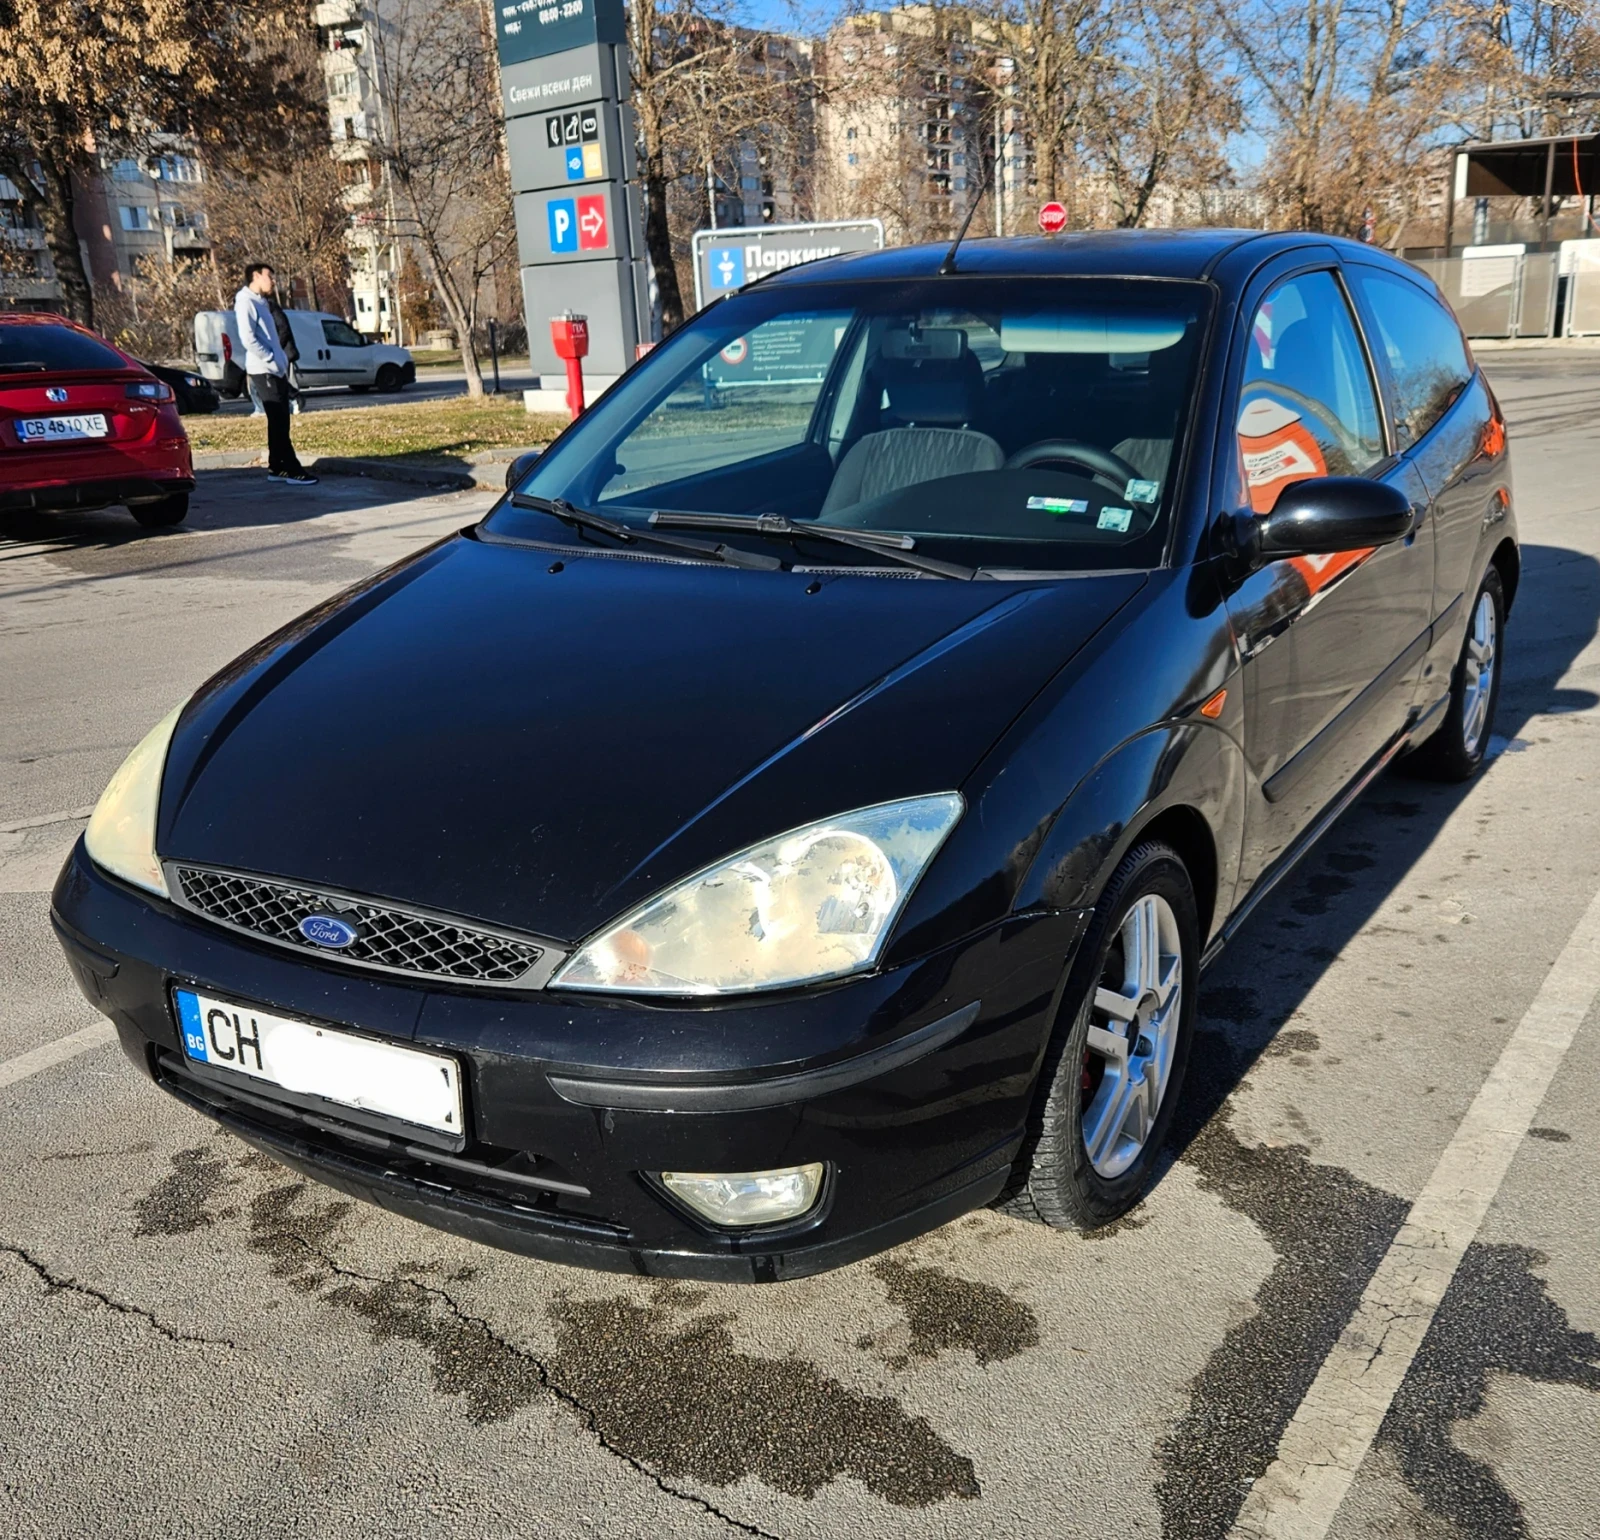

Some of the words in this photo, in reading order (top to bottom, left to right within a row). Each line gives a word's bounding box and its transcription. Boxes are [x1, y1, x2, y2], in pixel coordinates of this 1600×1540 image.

[509, 85, 541, 104] Свежи
[541, 79, 571, 97] всеки
[571, 73, 593, 93] ден
[554, 208, 570, 244] P
[1041, 211, 1065, 223] STOP
[25, 420, 46, 436] CB
[48, 417, 83, 434] 4810
[86, 415, 104, 431] XE
[310, 921, 340, 942] Ford
[187, 1033, 205, 1052] BG
[207, 1008, 263, 1070] CH
